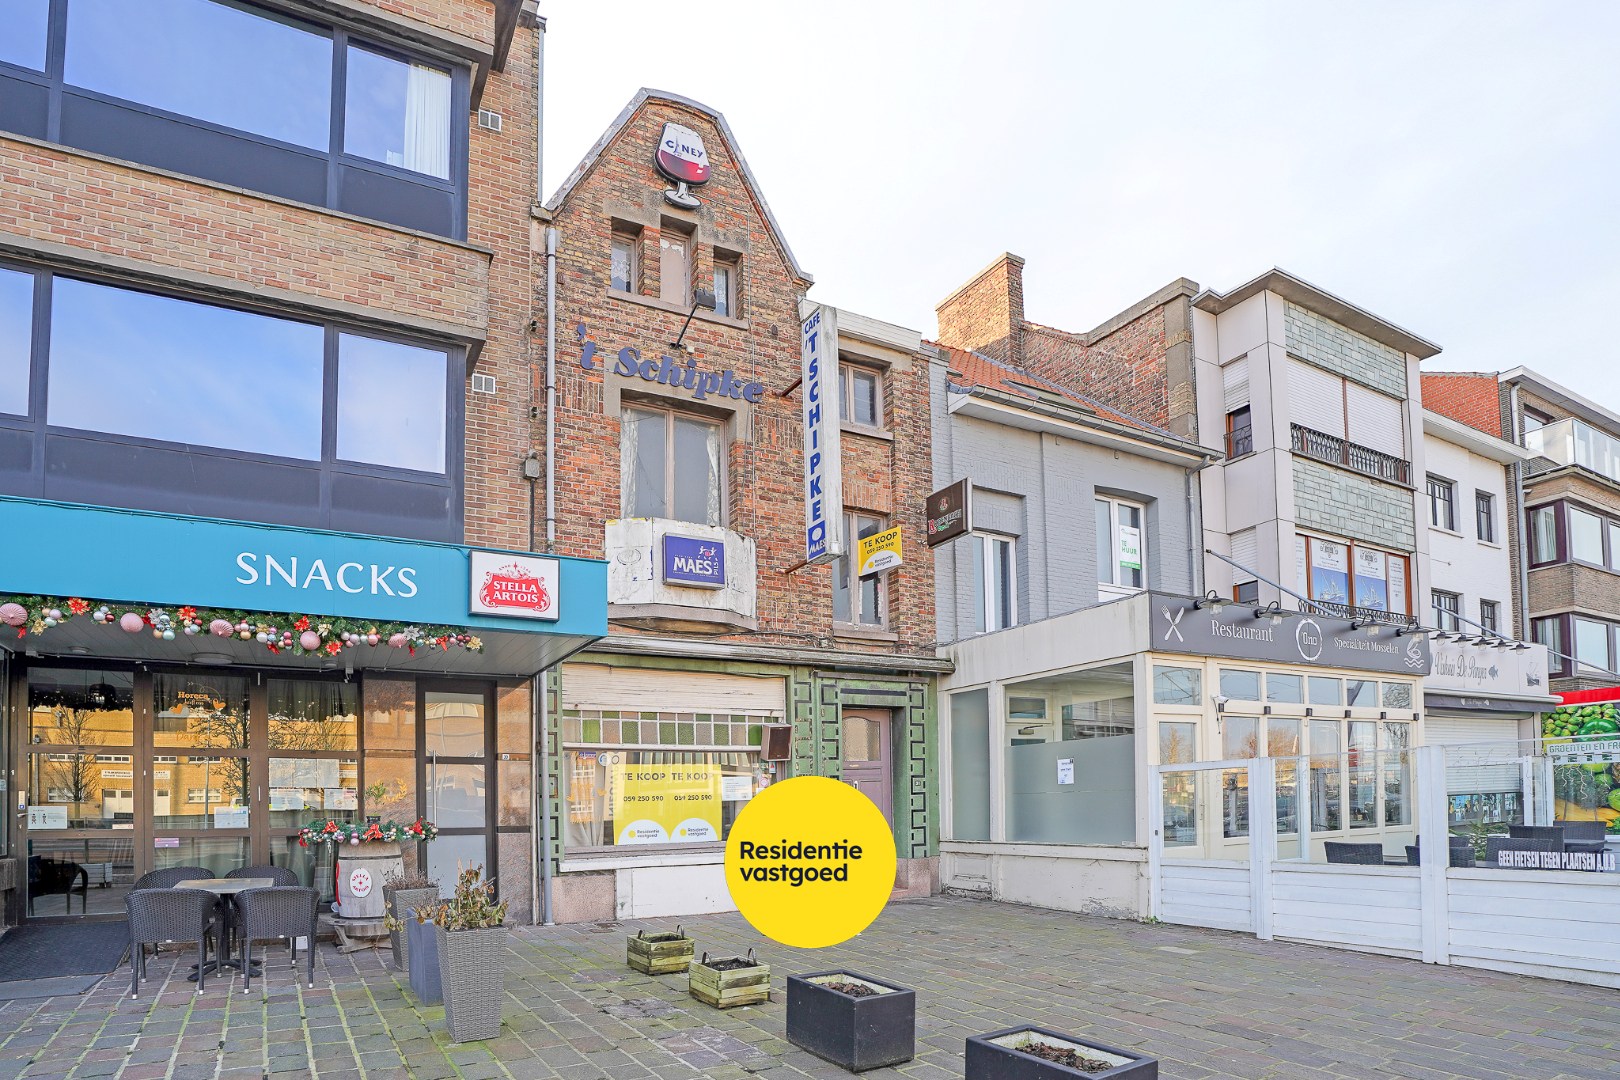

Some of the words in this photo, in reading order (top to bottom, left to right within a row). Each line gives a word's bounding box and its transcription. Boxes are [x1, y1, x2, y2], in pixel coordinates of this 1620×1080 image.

[665, 140, 703, 158] CINEY
[804, 312, 820, 334] CAFE
[577, 323, 598, 370] 't
[614, 346, 765, 403] Schipke
[809, 540, 825, 554] MAES
[864, 540, 873, 549] TE
[875, 531, 898, 545] KOOP
[1121, 547, 1137, 555] HUUR
[673, 556, 713, 575] MAES
[236, 552, 418, 598] SNACKS
[493, 580, 538, 593] STELLA
[493, 591, 539, 603] ARTOIS
[1210, 619, 1273, 642] Restaurant
[177, 691, 209, 699] Horeca
[1594, 742, 1605, 751] EN
[636, 772, 666, 781] KOOP
[671, 772, 684, 781] TE
[1498, 850, 1514, 867] GEEN
[1514, 851, 1540, 867] FIETSEN
[1540, 851, 1561, 869] TEGEN
[1561, 852, 1596, 870] PLAATSEN
